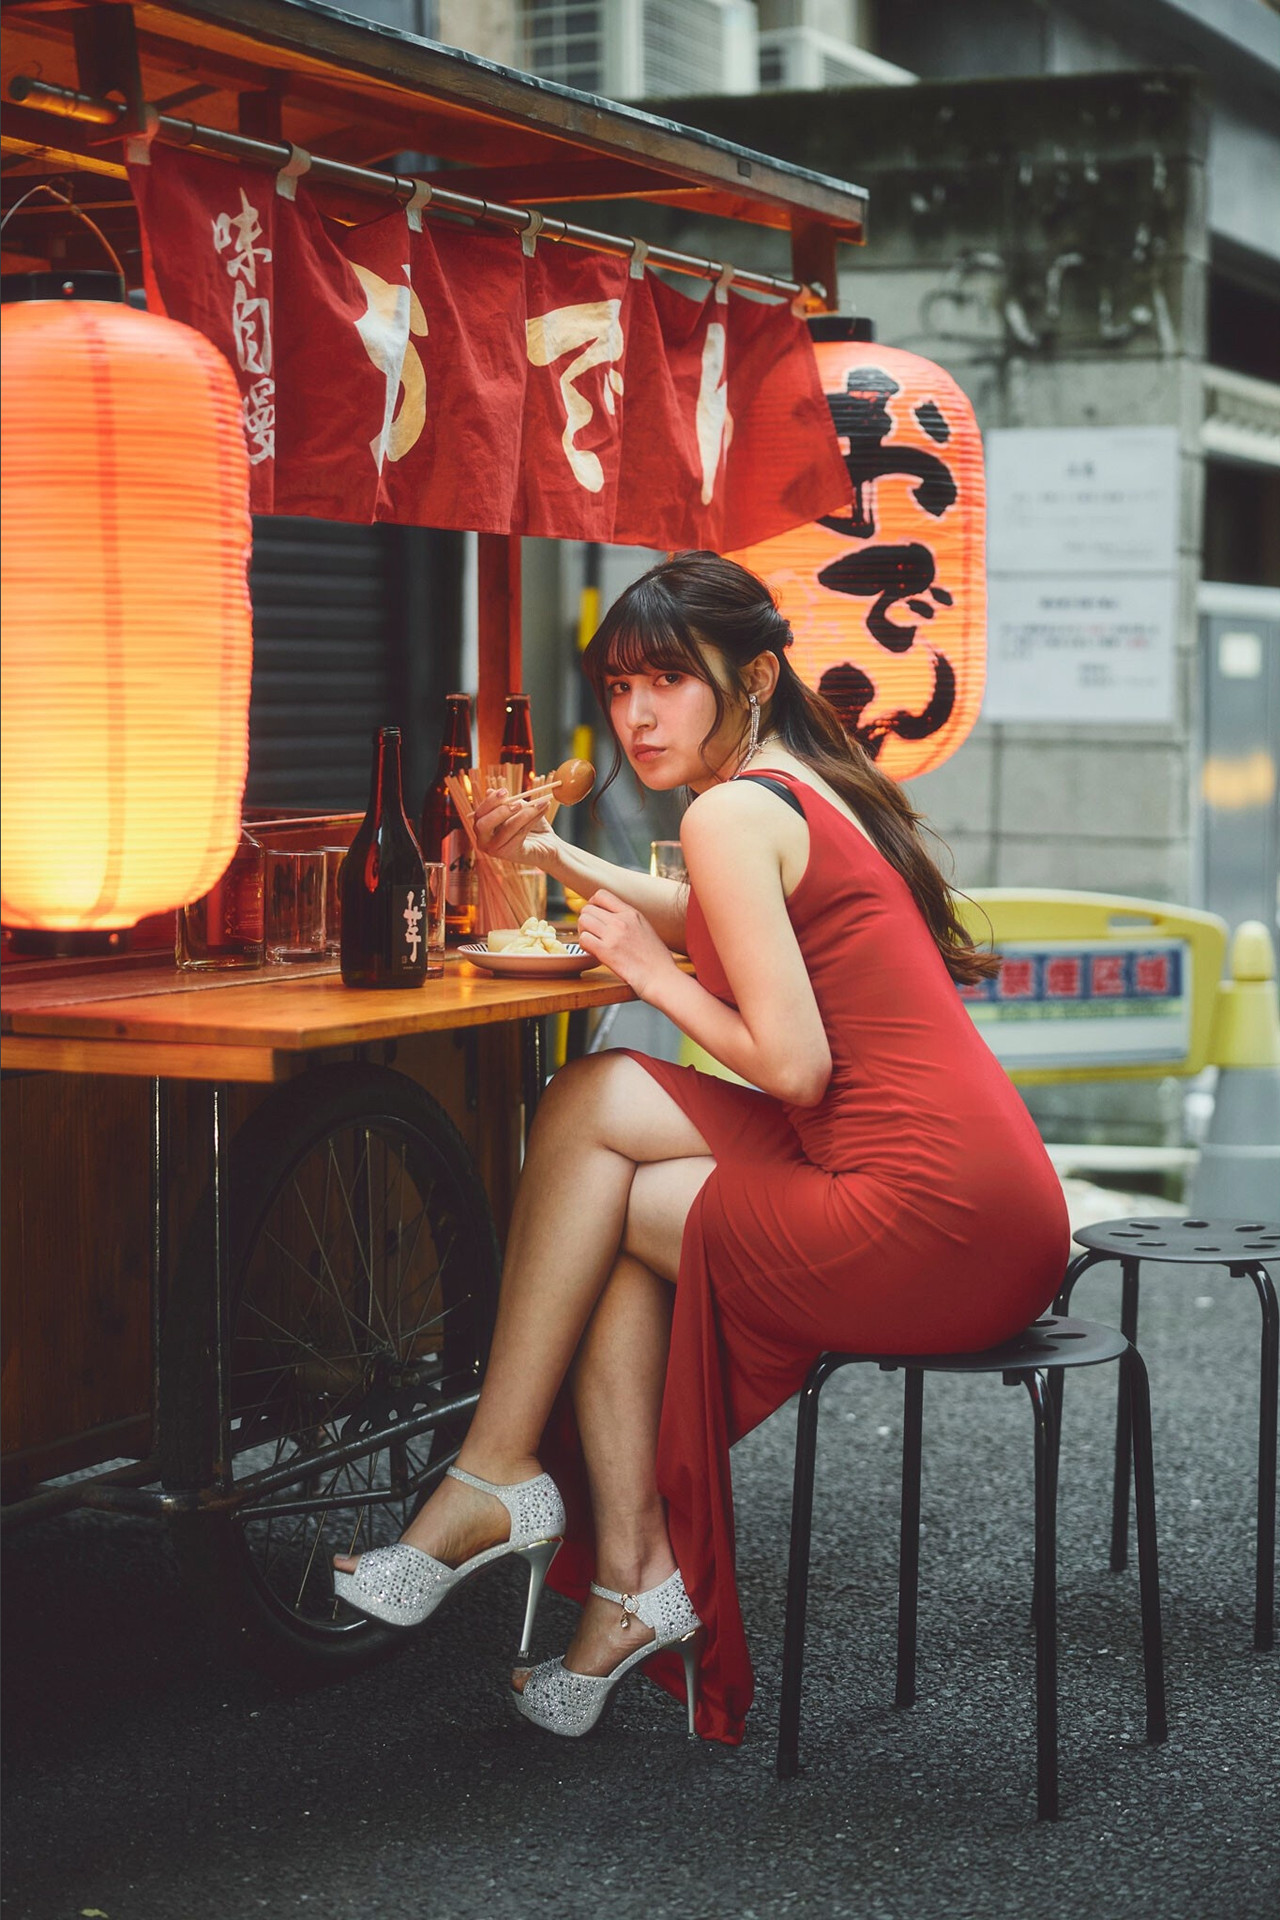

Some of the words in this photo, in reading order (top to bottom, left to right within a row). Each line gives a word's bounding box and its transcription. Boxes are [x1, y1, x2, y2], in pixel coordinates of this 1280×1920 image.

[211, 187, 275, 466] 味自慢
[815, 366, 958, 762] おでん
